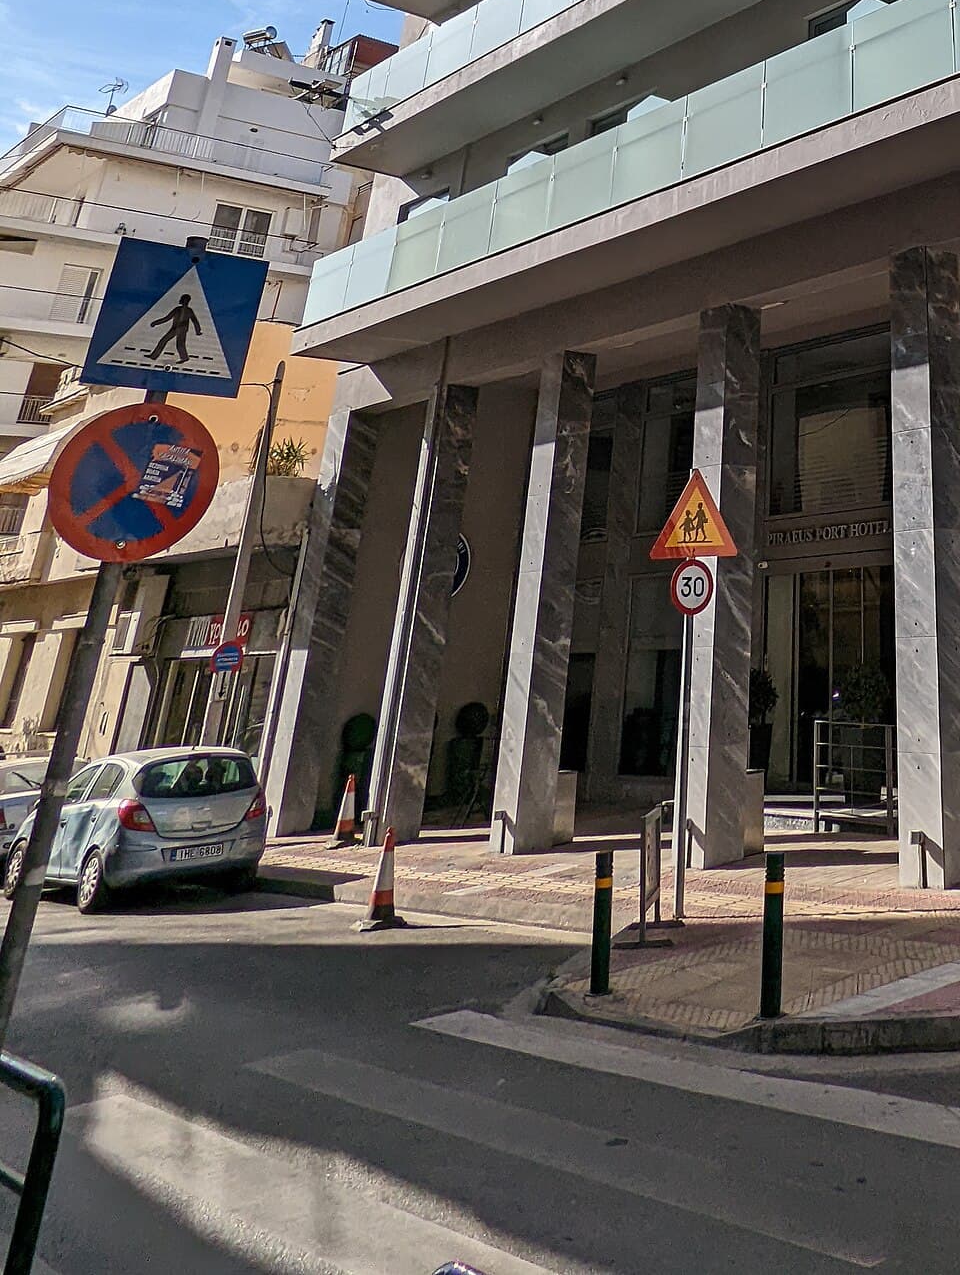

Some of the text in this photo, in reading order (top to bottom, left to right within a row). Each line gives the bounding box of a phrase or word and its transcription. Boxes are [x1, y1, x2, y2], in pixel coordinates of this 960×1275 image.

[767, 520, 891, 546] PIRAEUS PORT HOTEL
[681, 576, 704, 597] 30
